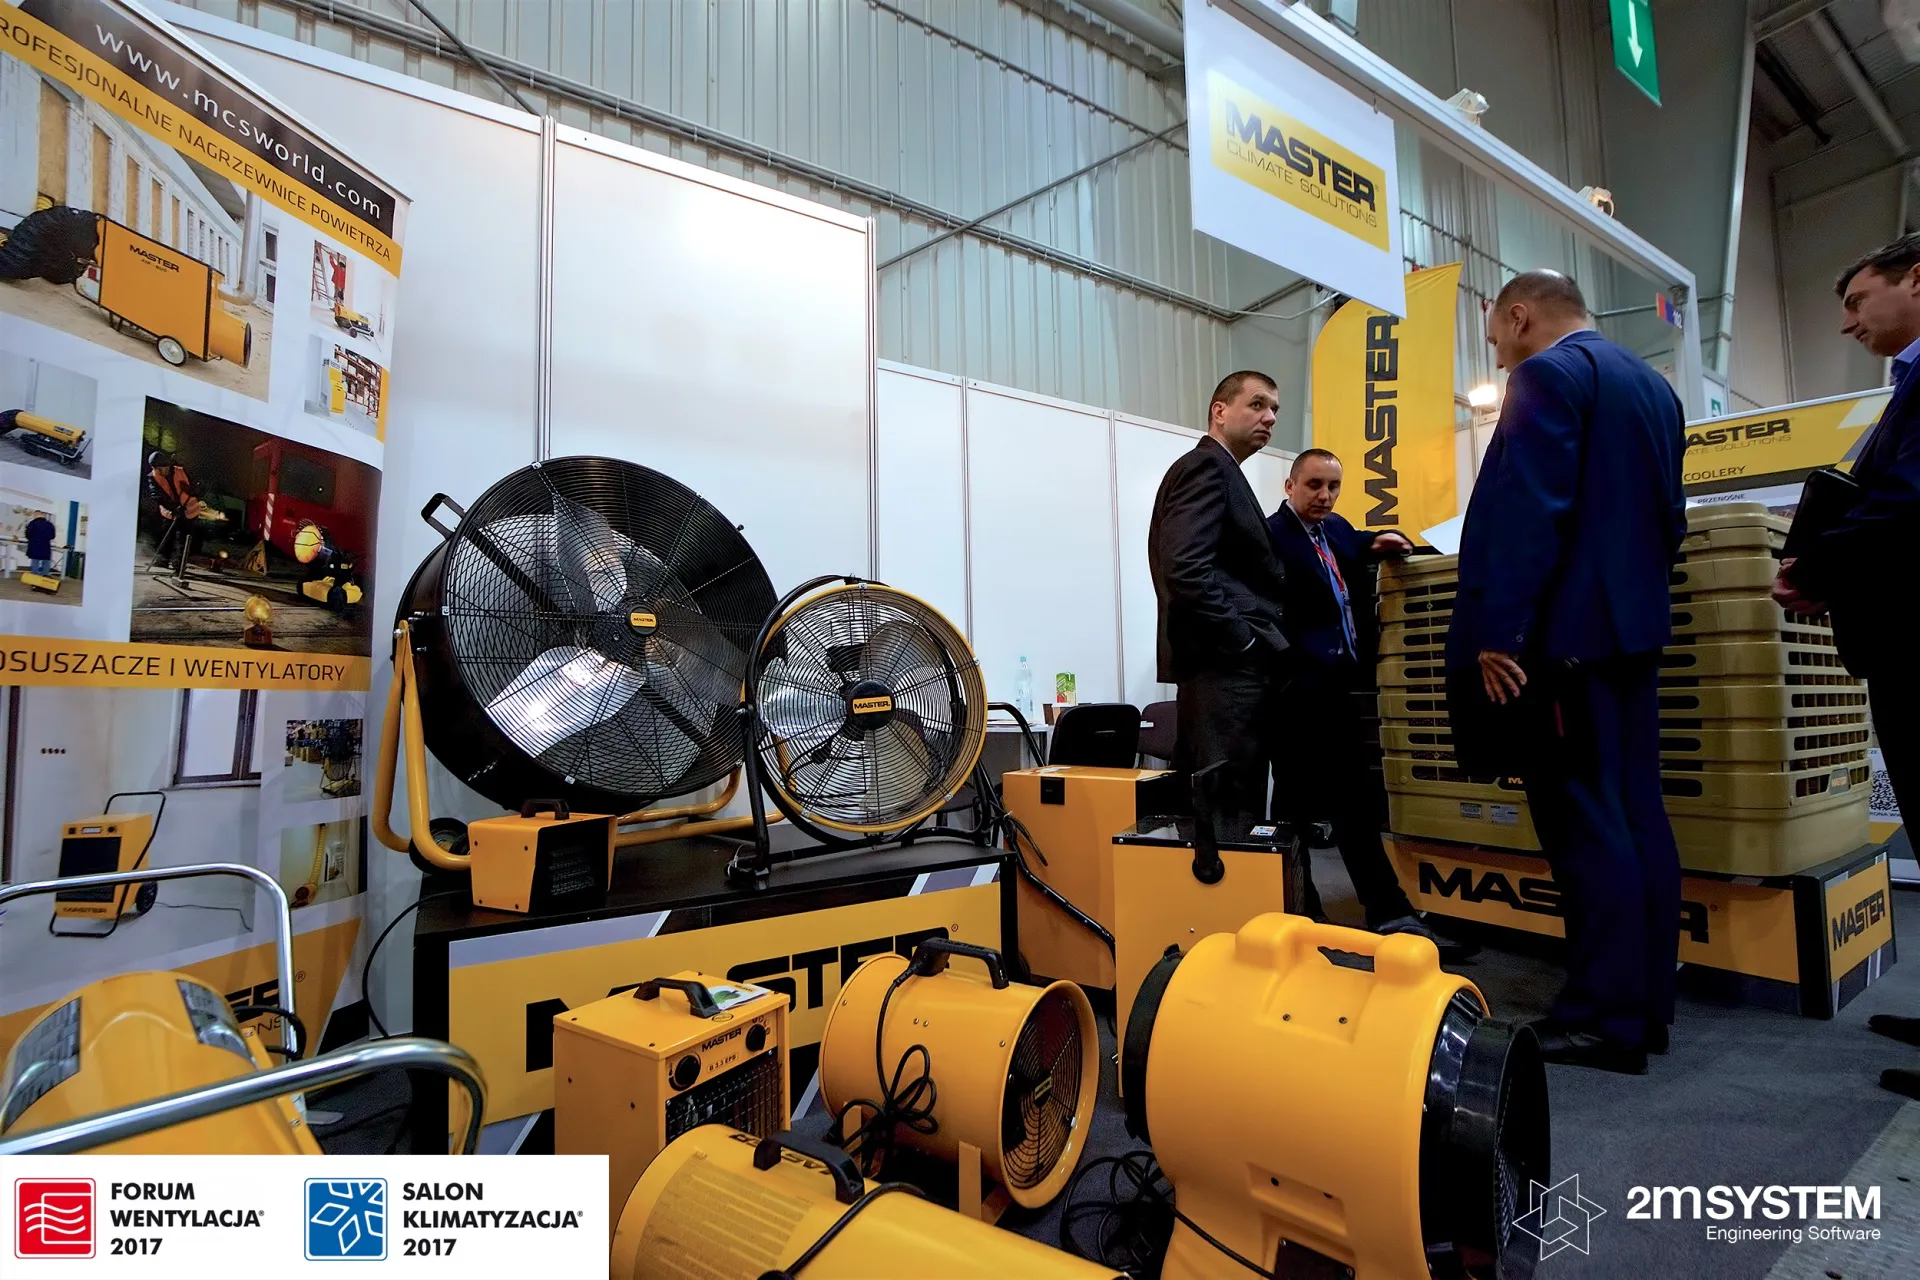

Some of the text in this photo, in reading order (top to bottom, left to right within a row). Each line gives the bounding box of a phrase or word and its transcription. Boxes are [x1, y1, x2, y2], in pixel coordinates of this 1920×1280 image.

[0, 16, 392, 262] ROFESJONALNE NAGRZEWNICE POWIETRZA
[96, 23, 382, 220] www.mcsworld.com
[1226, 98, 1376, 212] MASTER
[1227, 138, 1377, 228] CLIMATE SOLUTIONS
[129, 244, 180, 273] MASTER
[1364, 315, 1400, 527] MASTER
[1686, 418, 1791, 449] ASTER
[0, 651, 346, 682] SUSZACZE I WENTYLATORY
[1832, 889, 1885, 951] MASTER
[701, 1027, 742, 1052] MASTER
